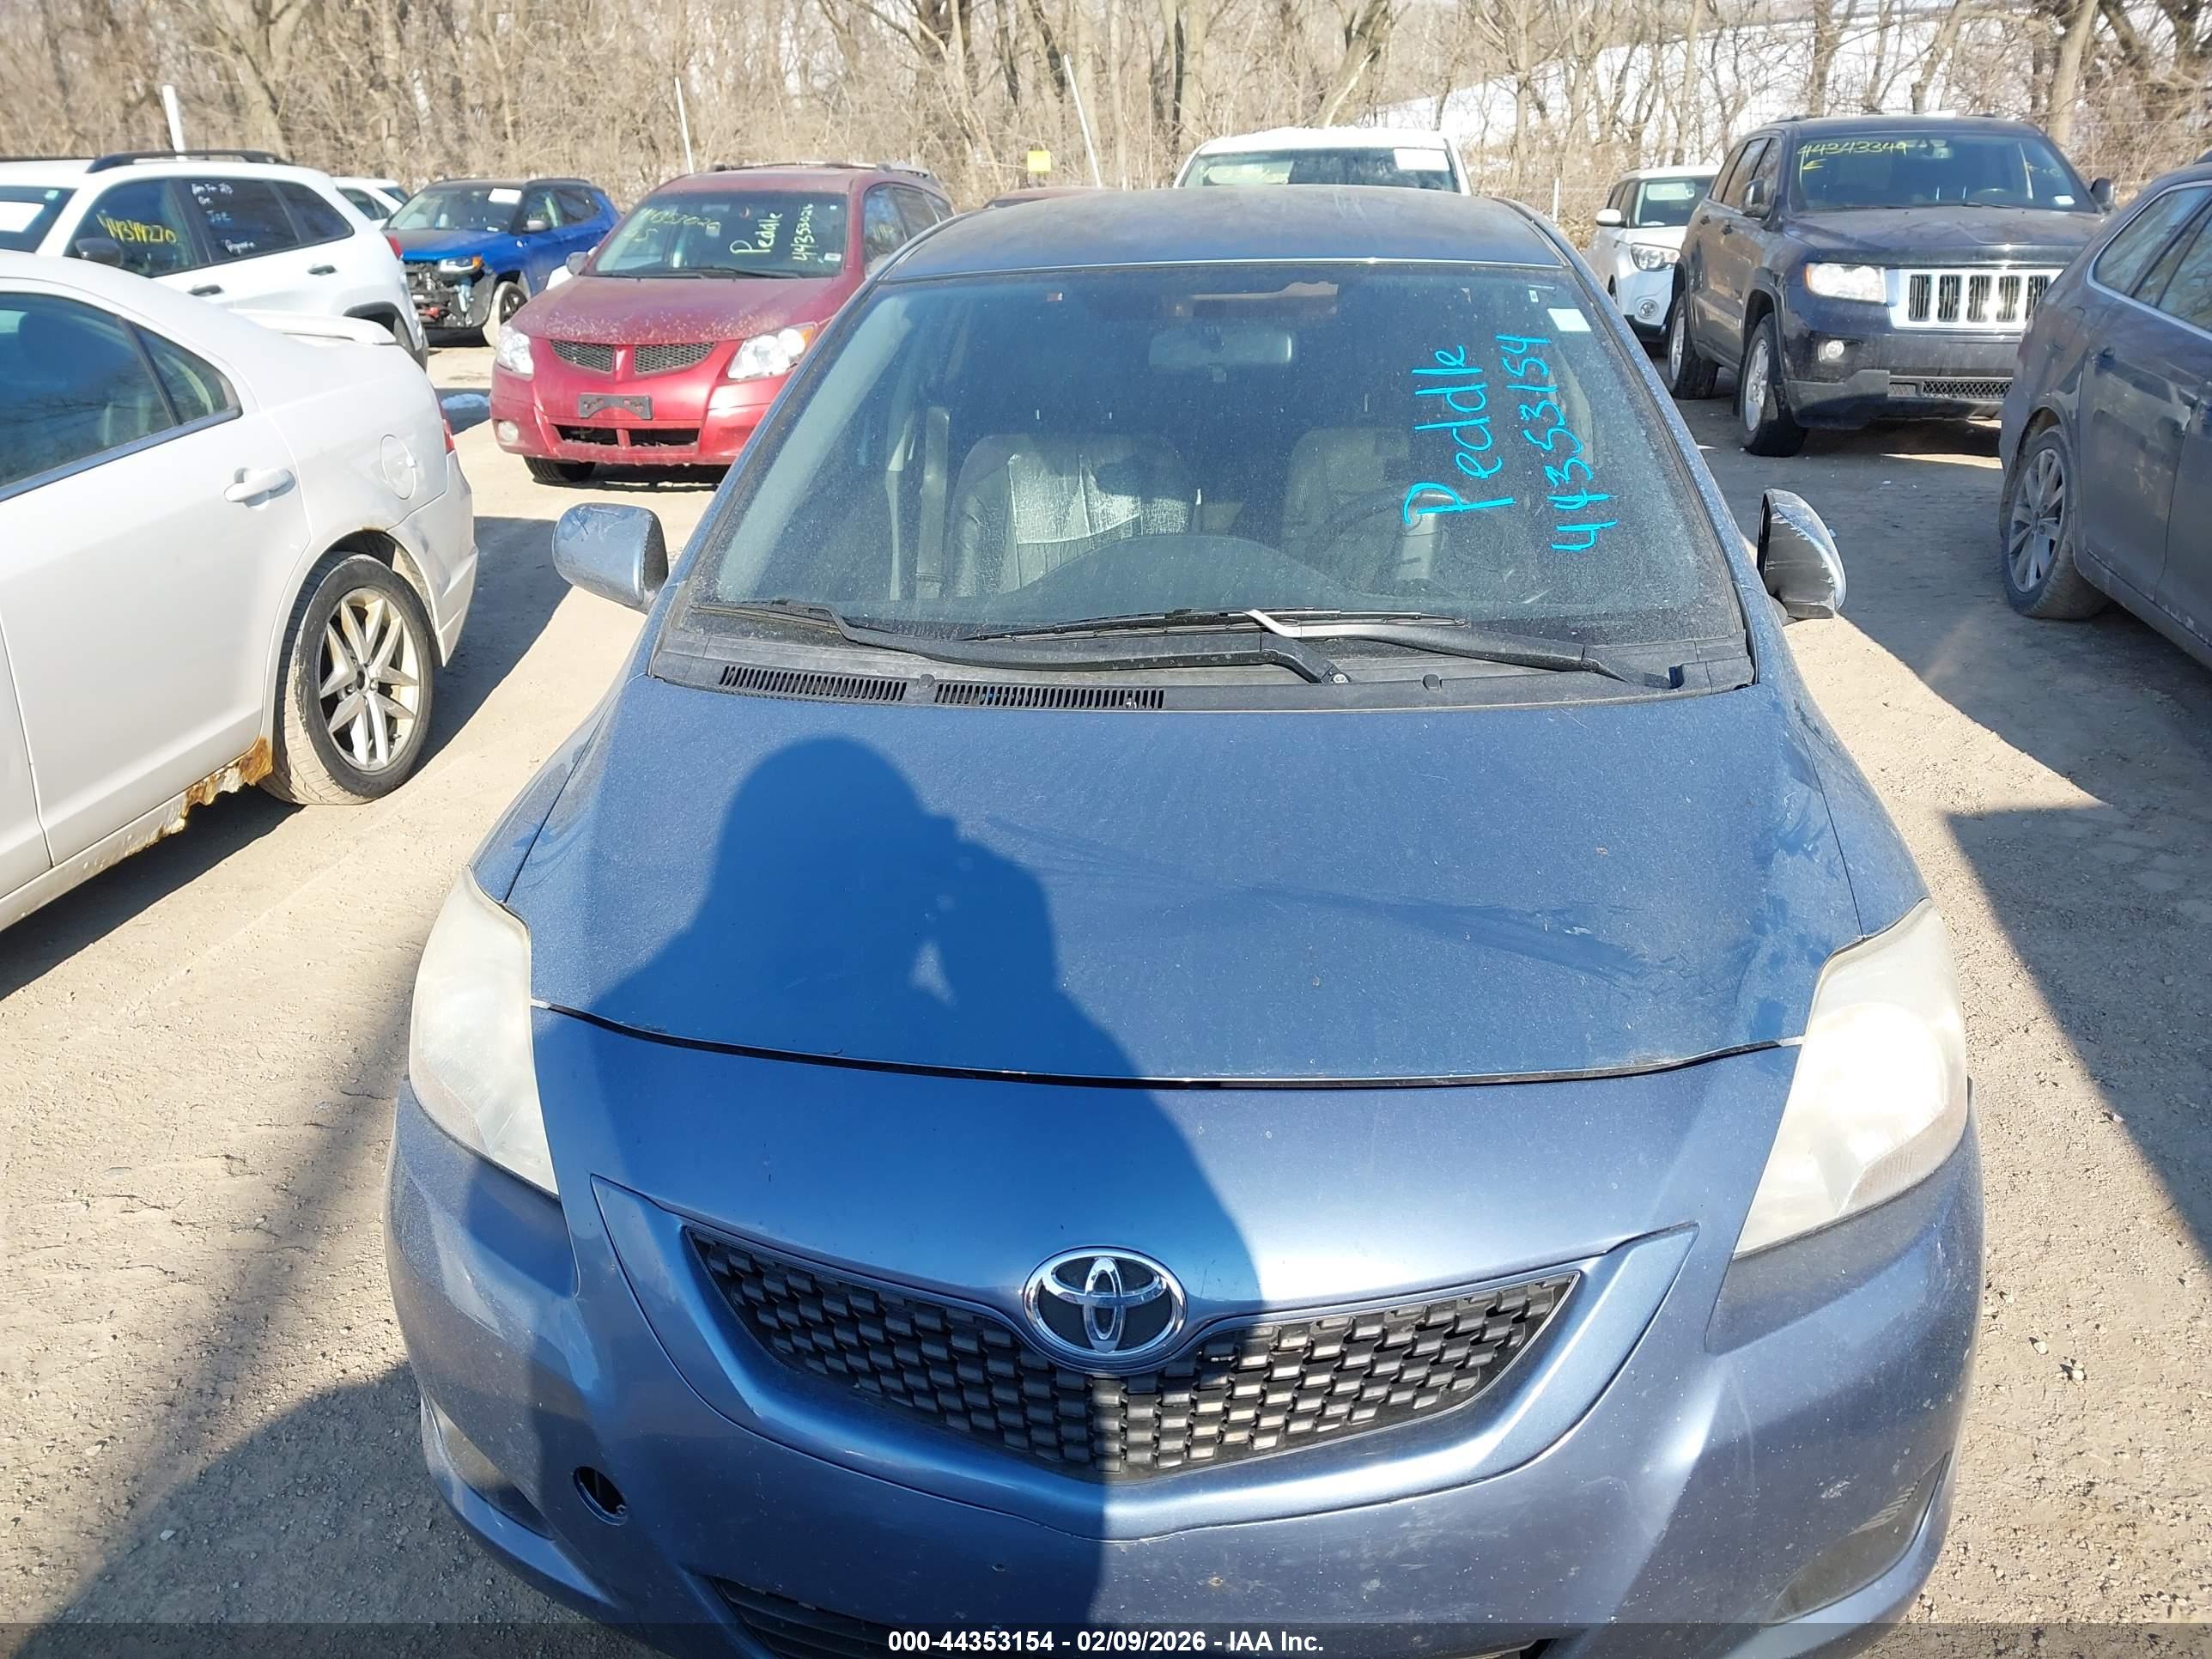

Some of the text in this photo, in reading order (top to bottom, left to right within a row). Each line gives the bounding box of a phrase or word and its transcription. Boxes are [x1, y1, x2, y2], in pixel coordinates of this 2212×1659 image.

[729, 212, 783, 254] Peddle
[1403, 344, 1516, 525] Peddle
[1496, 333, 1617, 552] 44353154
